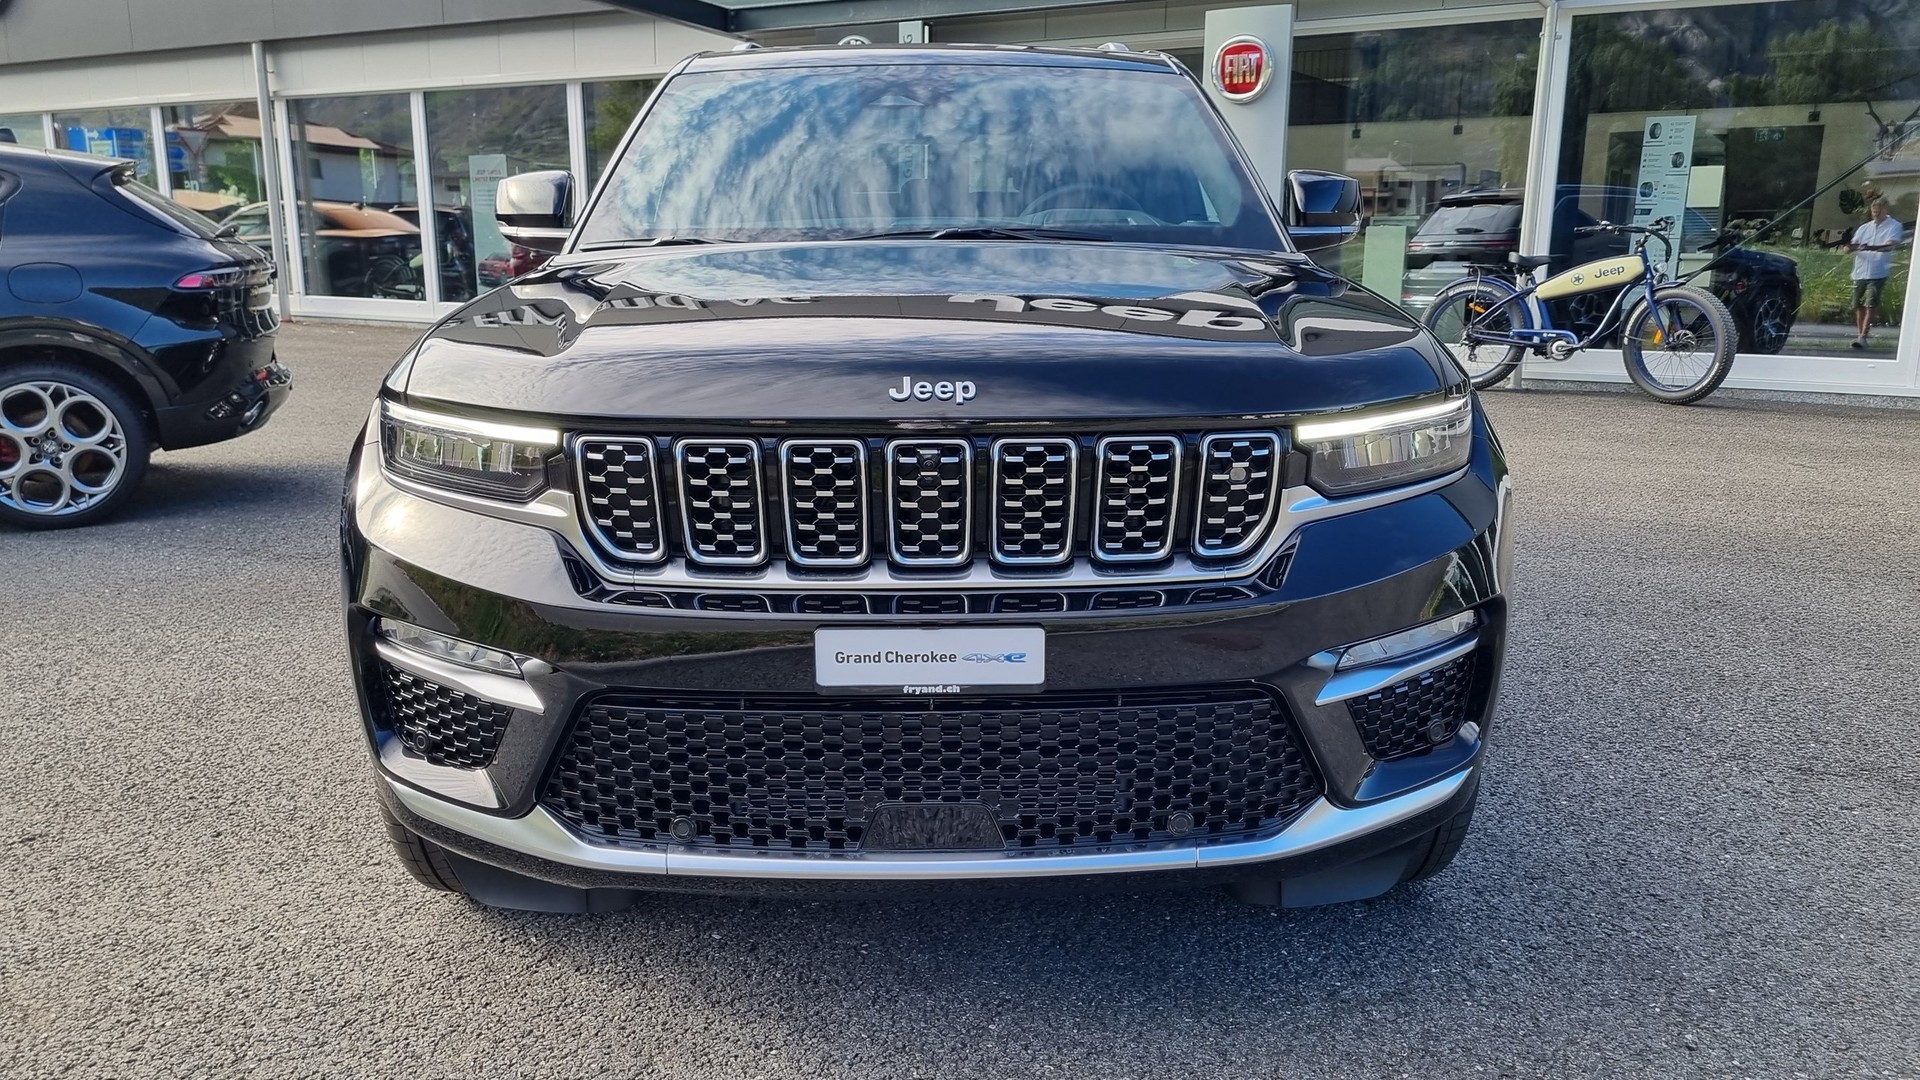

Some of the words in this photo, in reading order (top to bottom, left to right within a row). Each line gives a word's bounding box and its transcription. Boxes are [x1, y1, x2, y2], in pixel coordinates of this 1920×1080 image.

[1224, 53, 1261, 84] FIAT
[1594, 265, 1625, 280] Jeep
[888, 375, 977, 406] Jeep
[835, 651, 882, 664] Grand
[885, 651, 957, 664] Cherokee
[903, 684, 961, 695] fryand.ch
